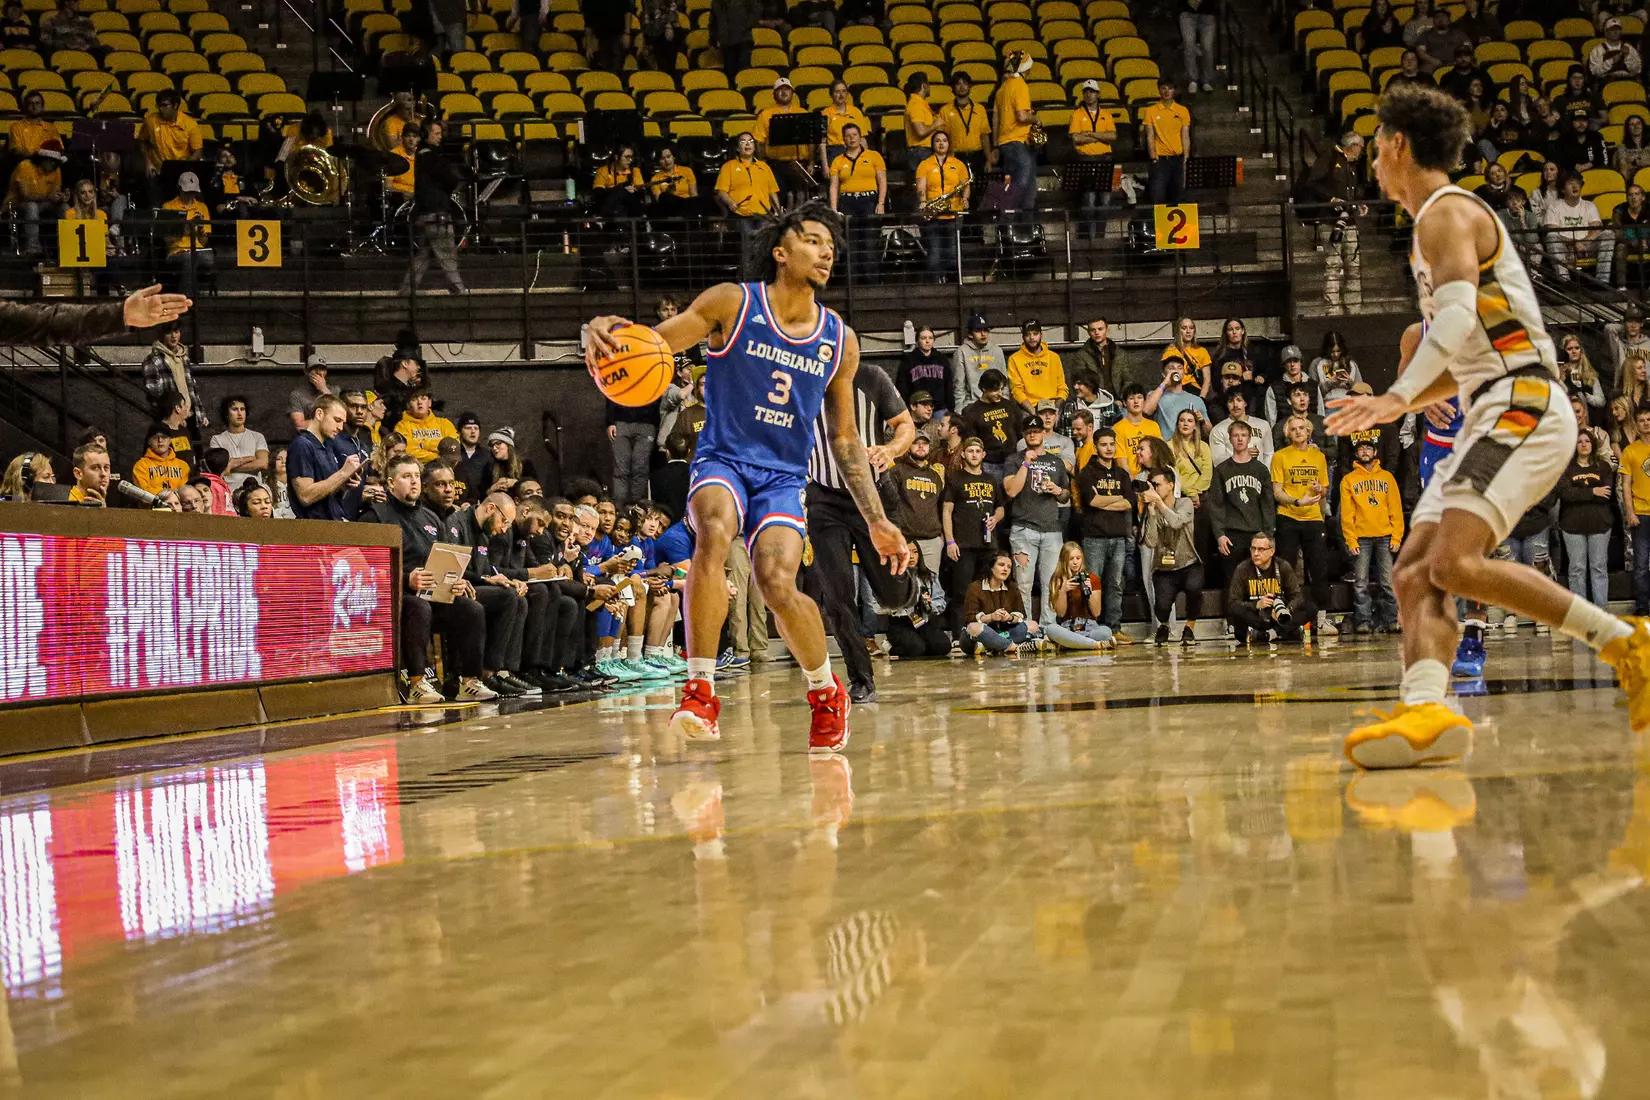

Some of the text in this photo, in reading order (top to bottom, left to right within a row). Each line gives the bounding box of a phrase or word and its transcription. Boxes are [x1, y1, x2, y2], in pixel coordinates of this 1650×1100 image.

[1167, 208, 1188, 245] 2
[75, 224, 90, 263] 1
[248, 224, 270, 263] 3
[746, 339, 825, 378] LOUISIANA
[601, 367, 629, 387] NCAA
[767, 369, 793, 406] 3
[754, 405, 795, 428] TECH
[1351, 429, 1381, 441] WYOMING
[148, 464, 183, 480] WYOMING
[969, 489, 993, 498] BUCK
[1225, 474, 1262, 496] WYOMING
[1353, 479, 1389, 496] WYOMING
